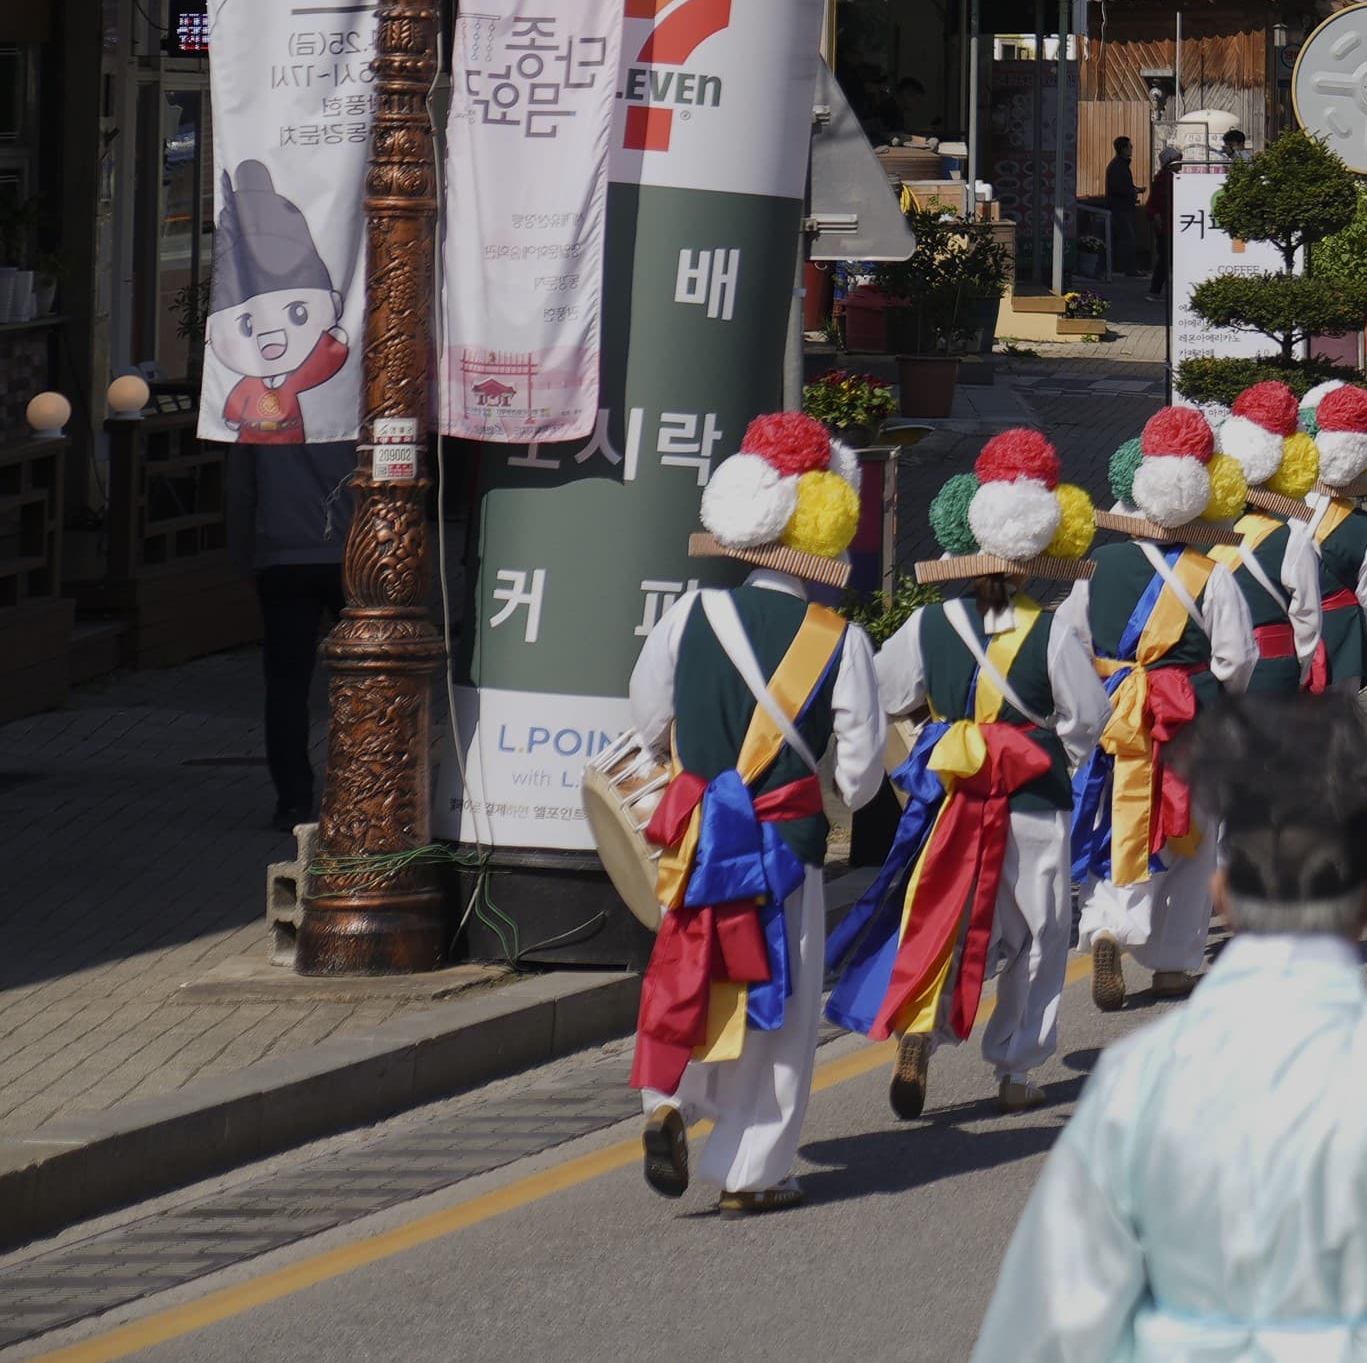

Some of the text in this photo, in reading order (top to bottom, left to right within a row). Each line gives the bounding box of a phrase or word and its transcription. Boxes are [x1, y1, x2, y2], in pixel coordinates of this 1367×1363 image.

[1217, 265, 1260, 275] COFFEE
[674, 248, 740, 320] 배
[511, 768, 550, 789] with
